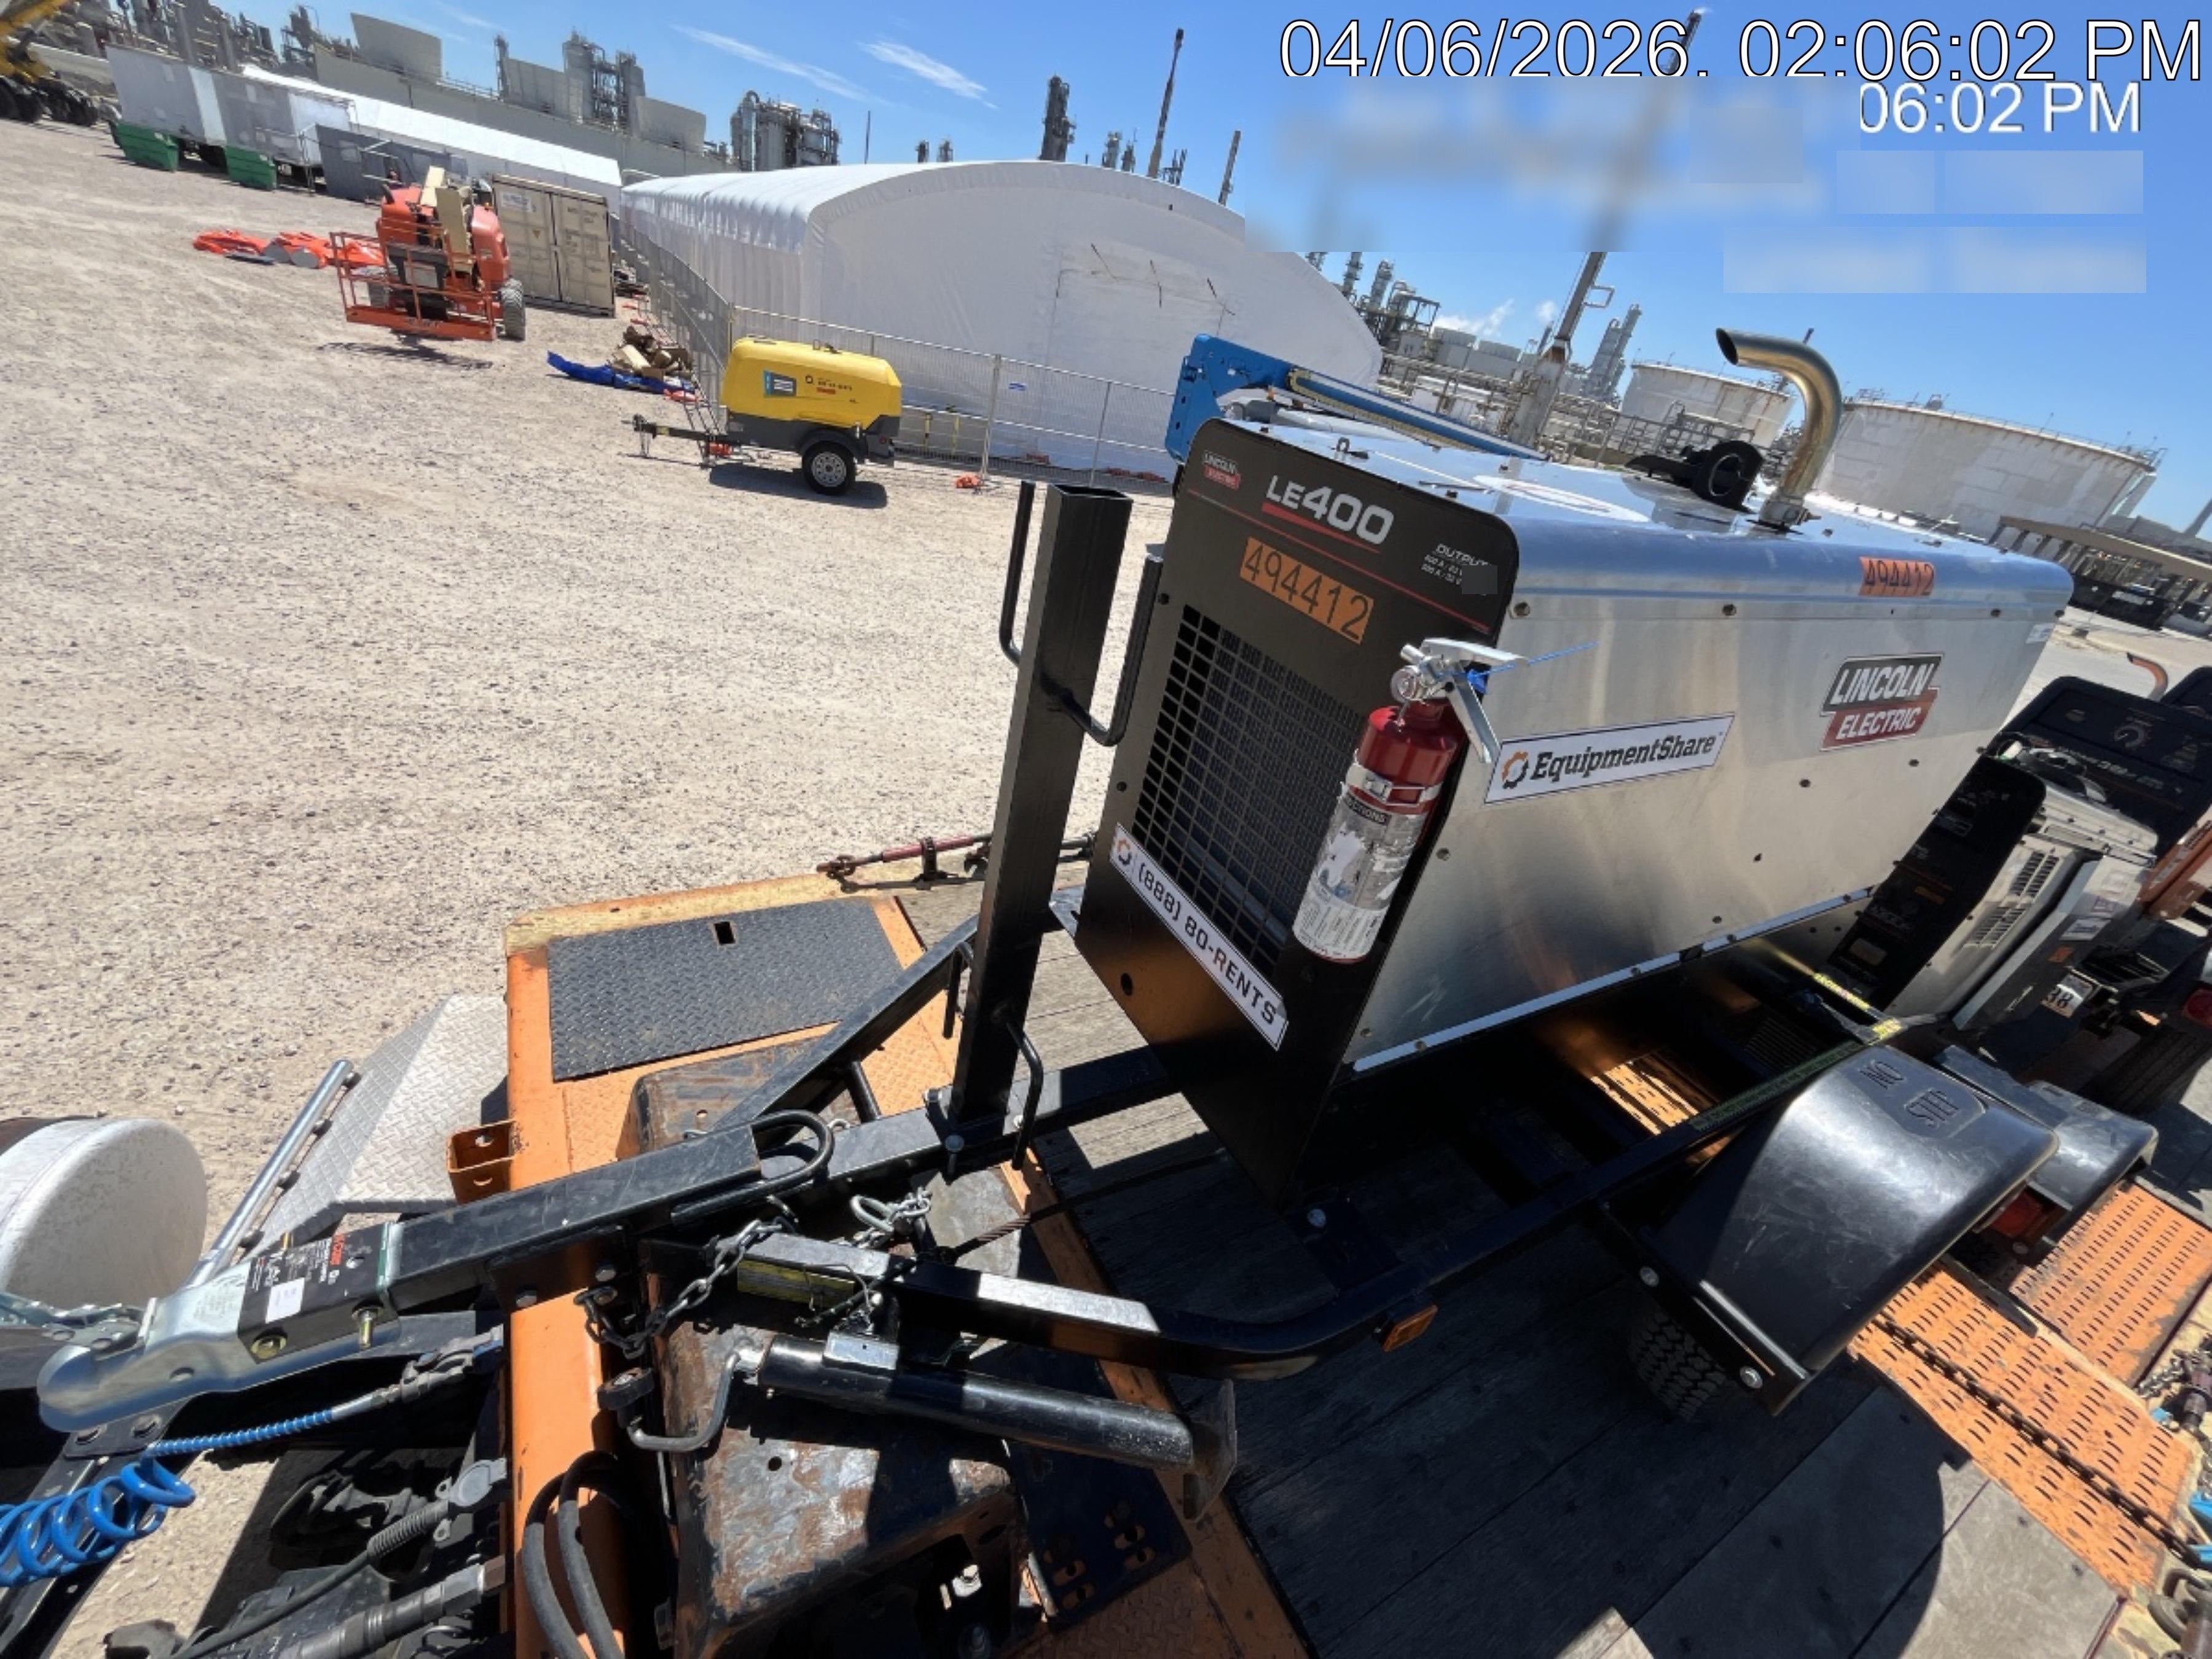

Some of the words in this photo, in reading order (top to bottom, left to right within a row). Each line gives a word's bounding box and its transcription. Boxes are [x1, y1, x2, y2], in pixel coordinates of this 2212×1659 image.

[1265, 475, 1394, 545] LE400
[1244, 544, 1371, 641] 494412
[1864, 559, 1935, 596] 494412
[1830, 663, 1935, 705] LINCOLN
[1835, 707, 1922, 740] ELECTRIC
[1530, 735, 1717, 783] EquipmentShare
[1139, 862, 1181, 921] (888)
[1184, 916, 1277, 1025] 80-RENTS
[1859, 1060, 1904, 1091] NO
[1905, 1088, 1960, 1128] STEP
